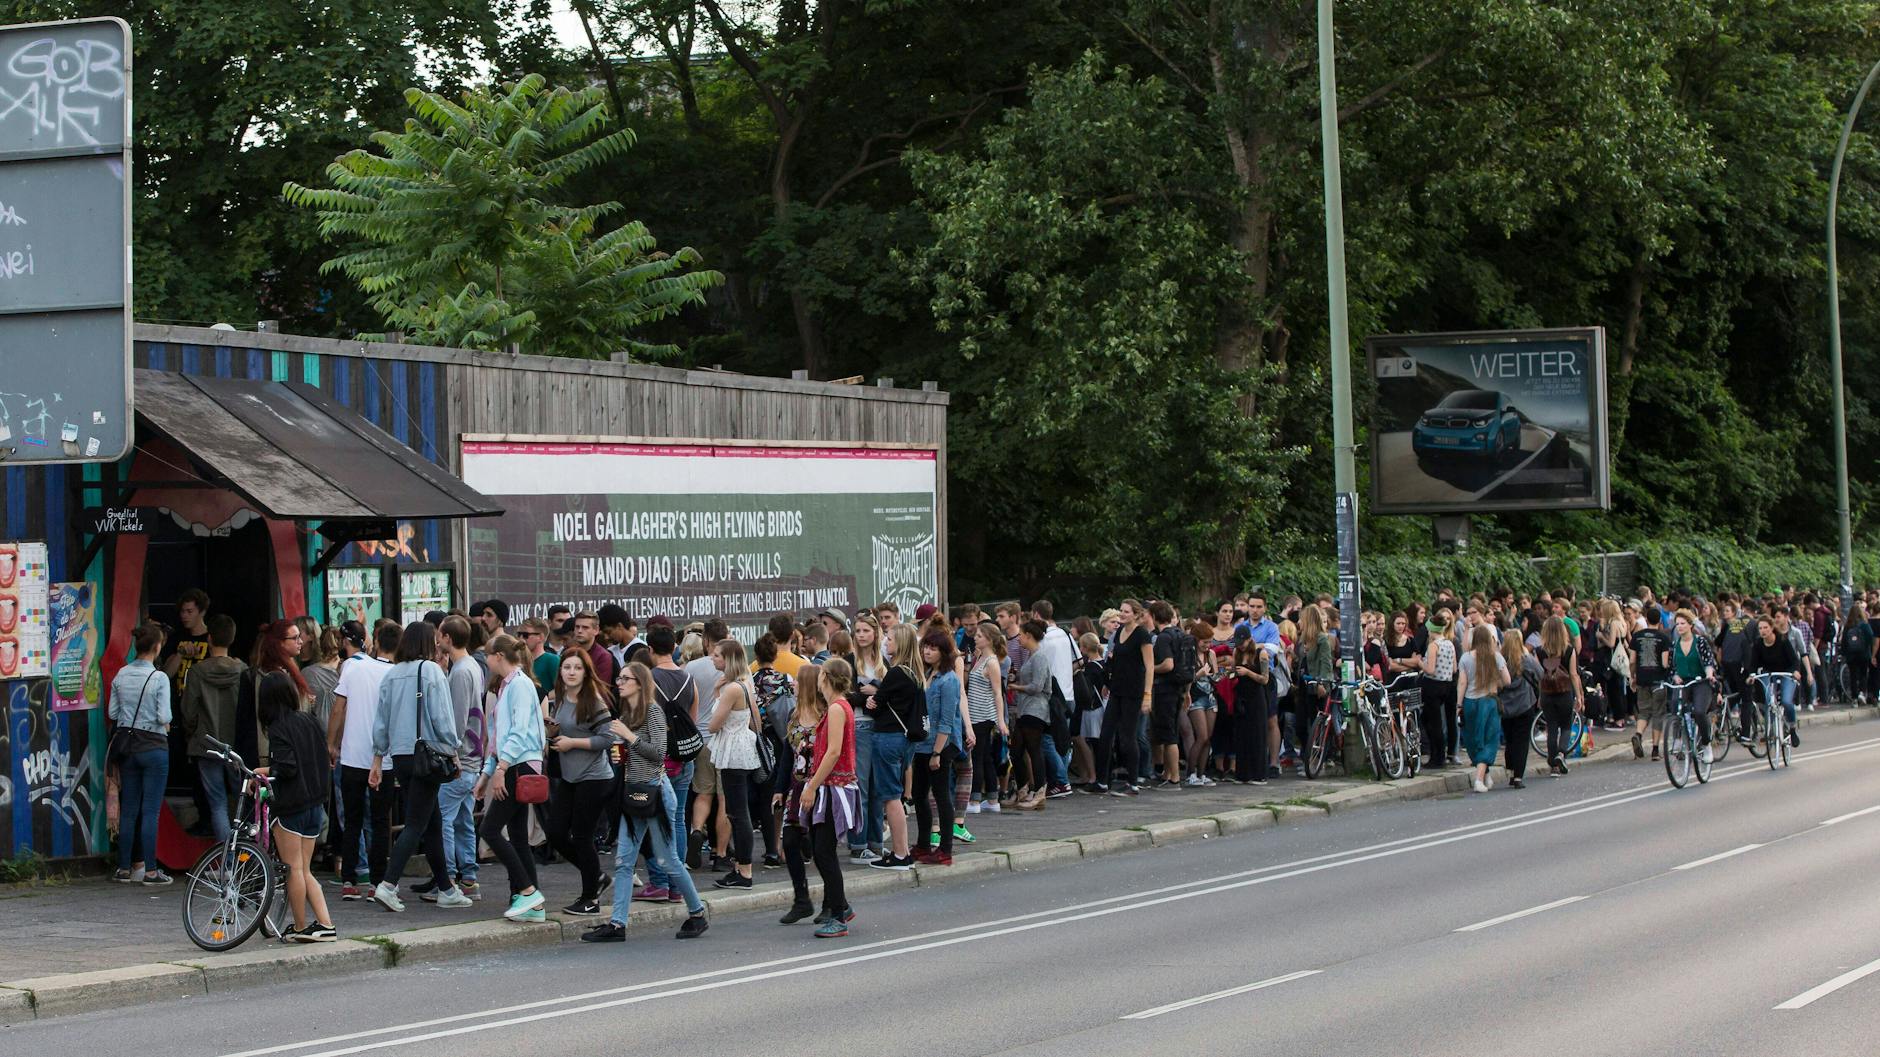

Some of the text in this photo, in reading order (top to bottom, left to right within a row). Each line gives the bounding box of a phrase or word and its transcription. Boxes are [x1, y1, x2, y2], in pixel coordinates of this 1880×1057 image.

[1470, 351, 1581, 379] WEITER.
[553, 510, 803, 541] NOEL GALLAGHER'S HIGH FLYING BIRDS
[583, 551, 782, 586] MANDO DIAO BAND OF SKULLS
[506, 603, 531, 627] ANK
[610, 596, 685, 619] TTLESNAKES
[692, 594, 718, 616] ABBY
[723, 594, 741, 615] THE
[743, 591, 764, 613] KING
[766, 590, 793, 612] BLUES
[799, 588, 814, 609] TIM
[816, 586, 850, 608] VANTOL
